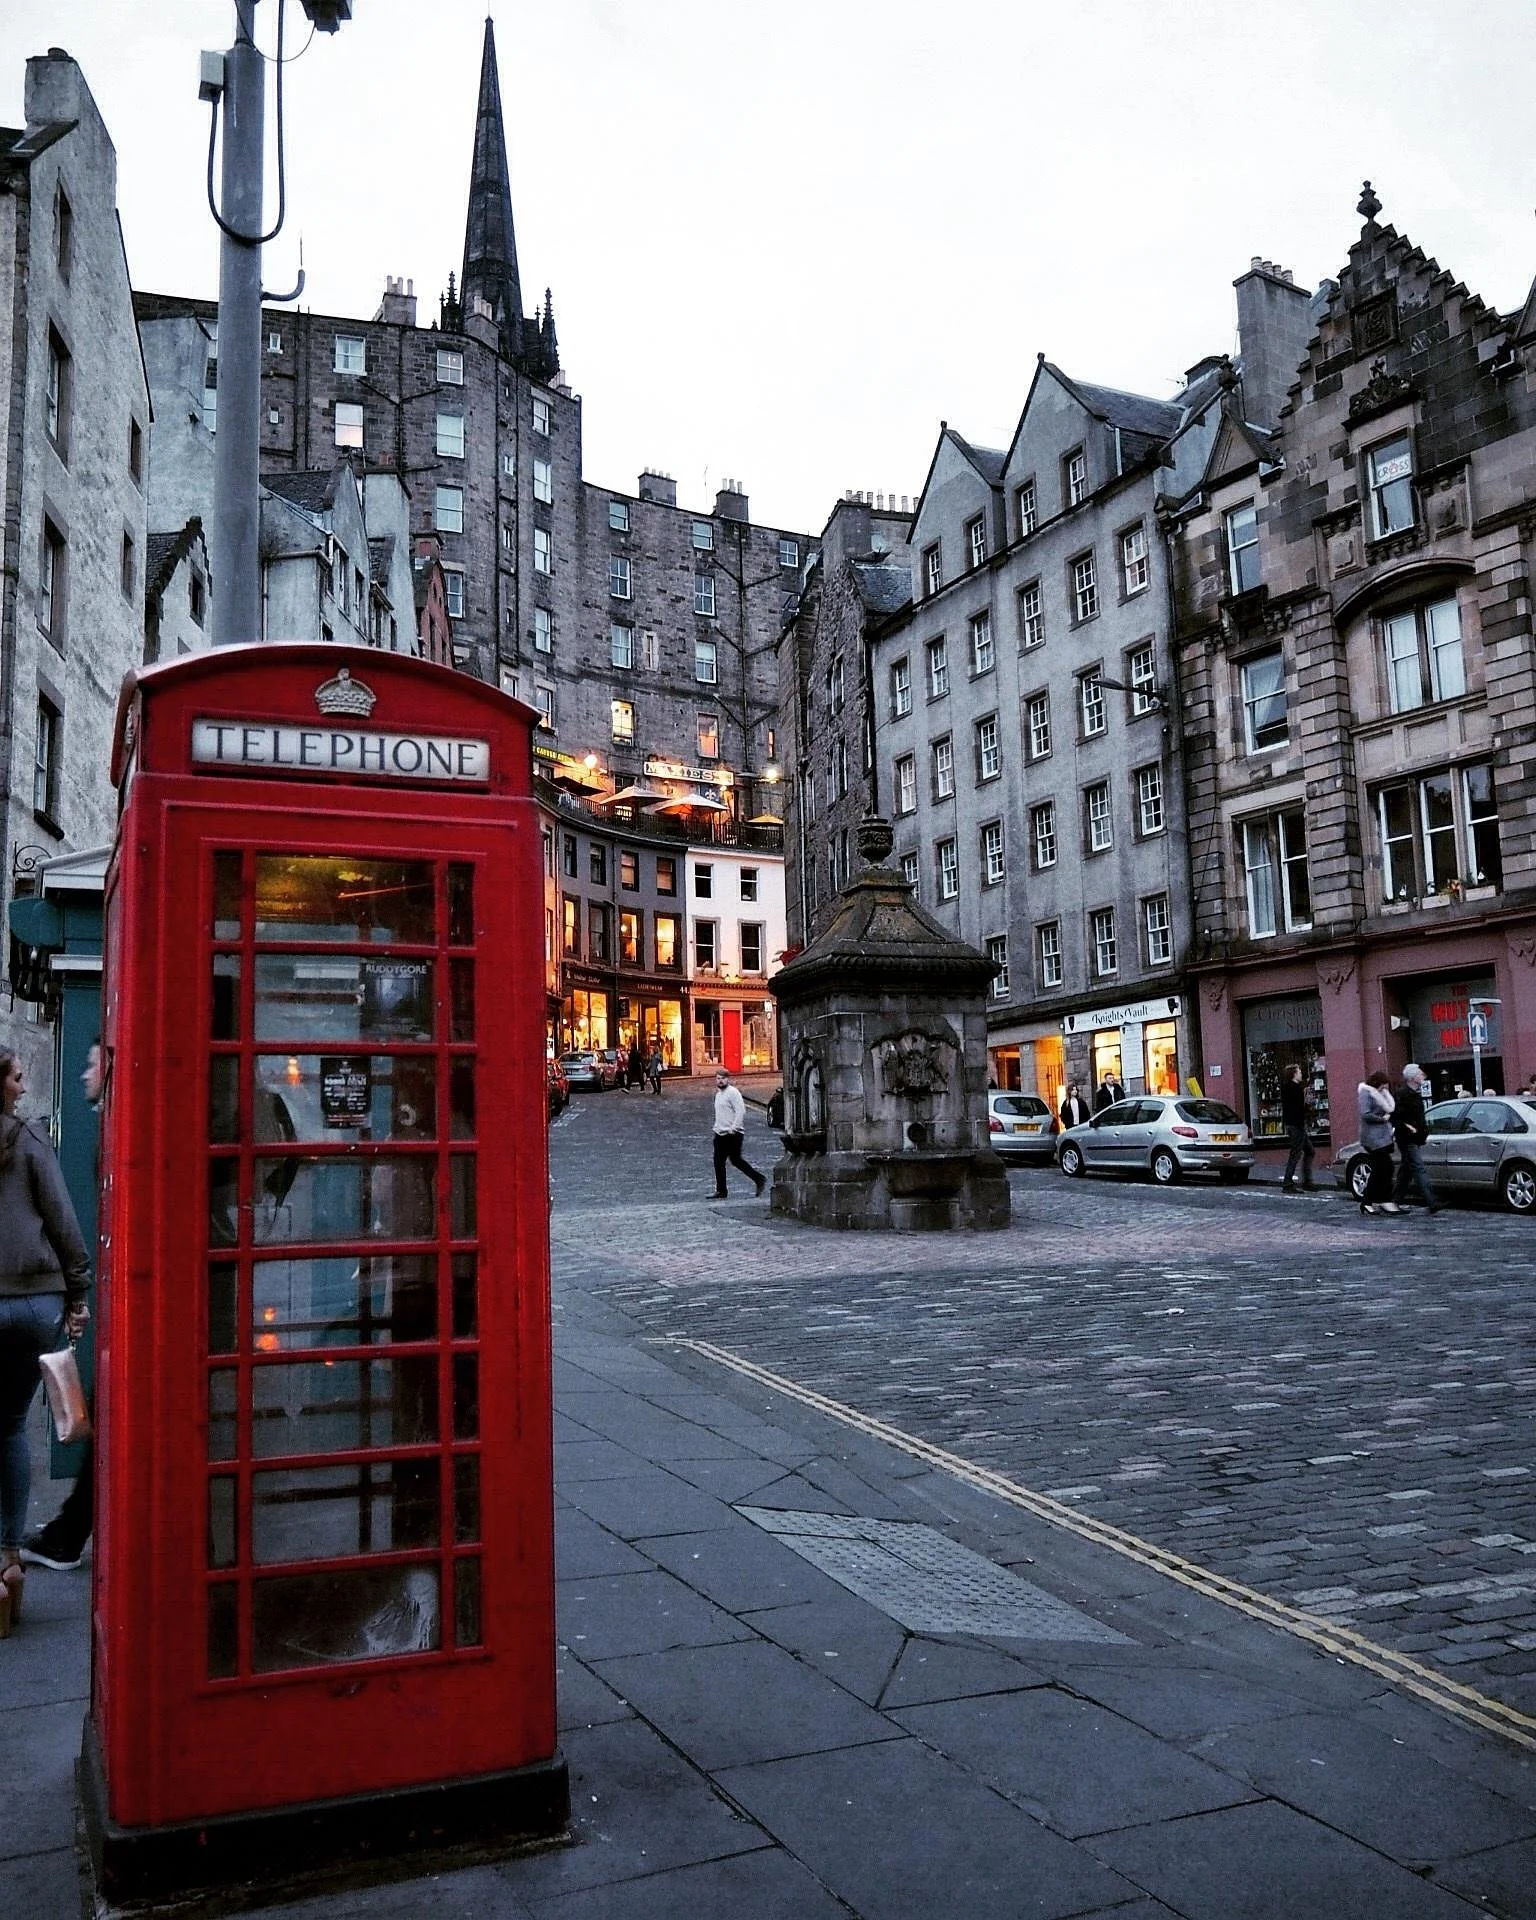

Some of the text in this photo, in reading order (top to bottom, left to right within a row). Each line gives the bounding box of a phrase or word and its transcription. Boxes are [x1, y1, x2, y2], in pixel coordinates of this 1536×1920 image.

[206, 726, 478, 776] TELEPHONE
[1092, 1009, 1124, 1024] Knights
[1124, 1005, 1148, 1020] Vault
